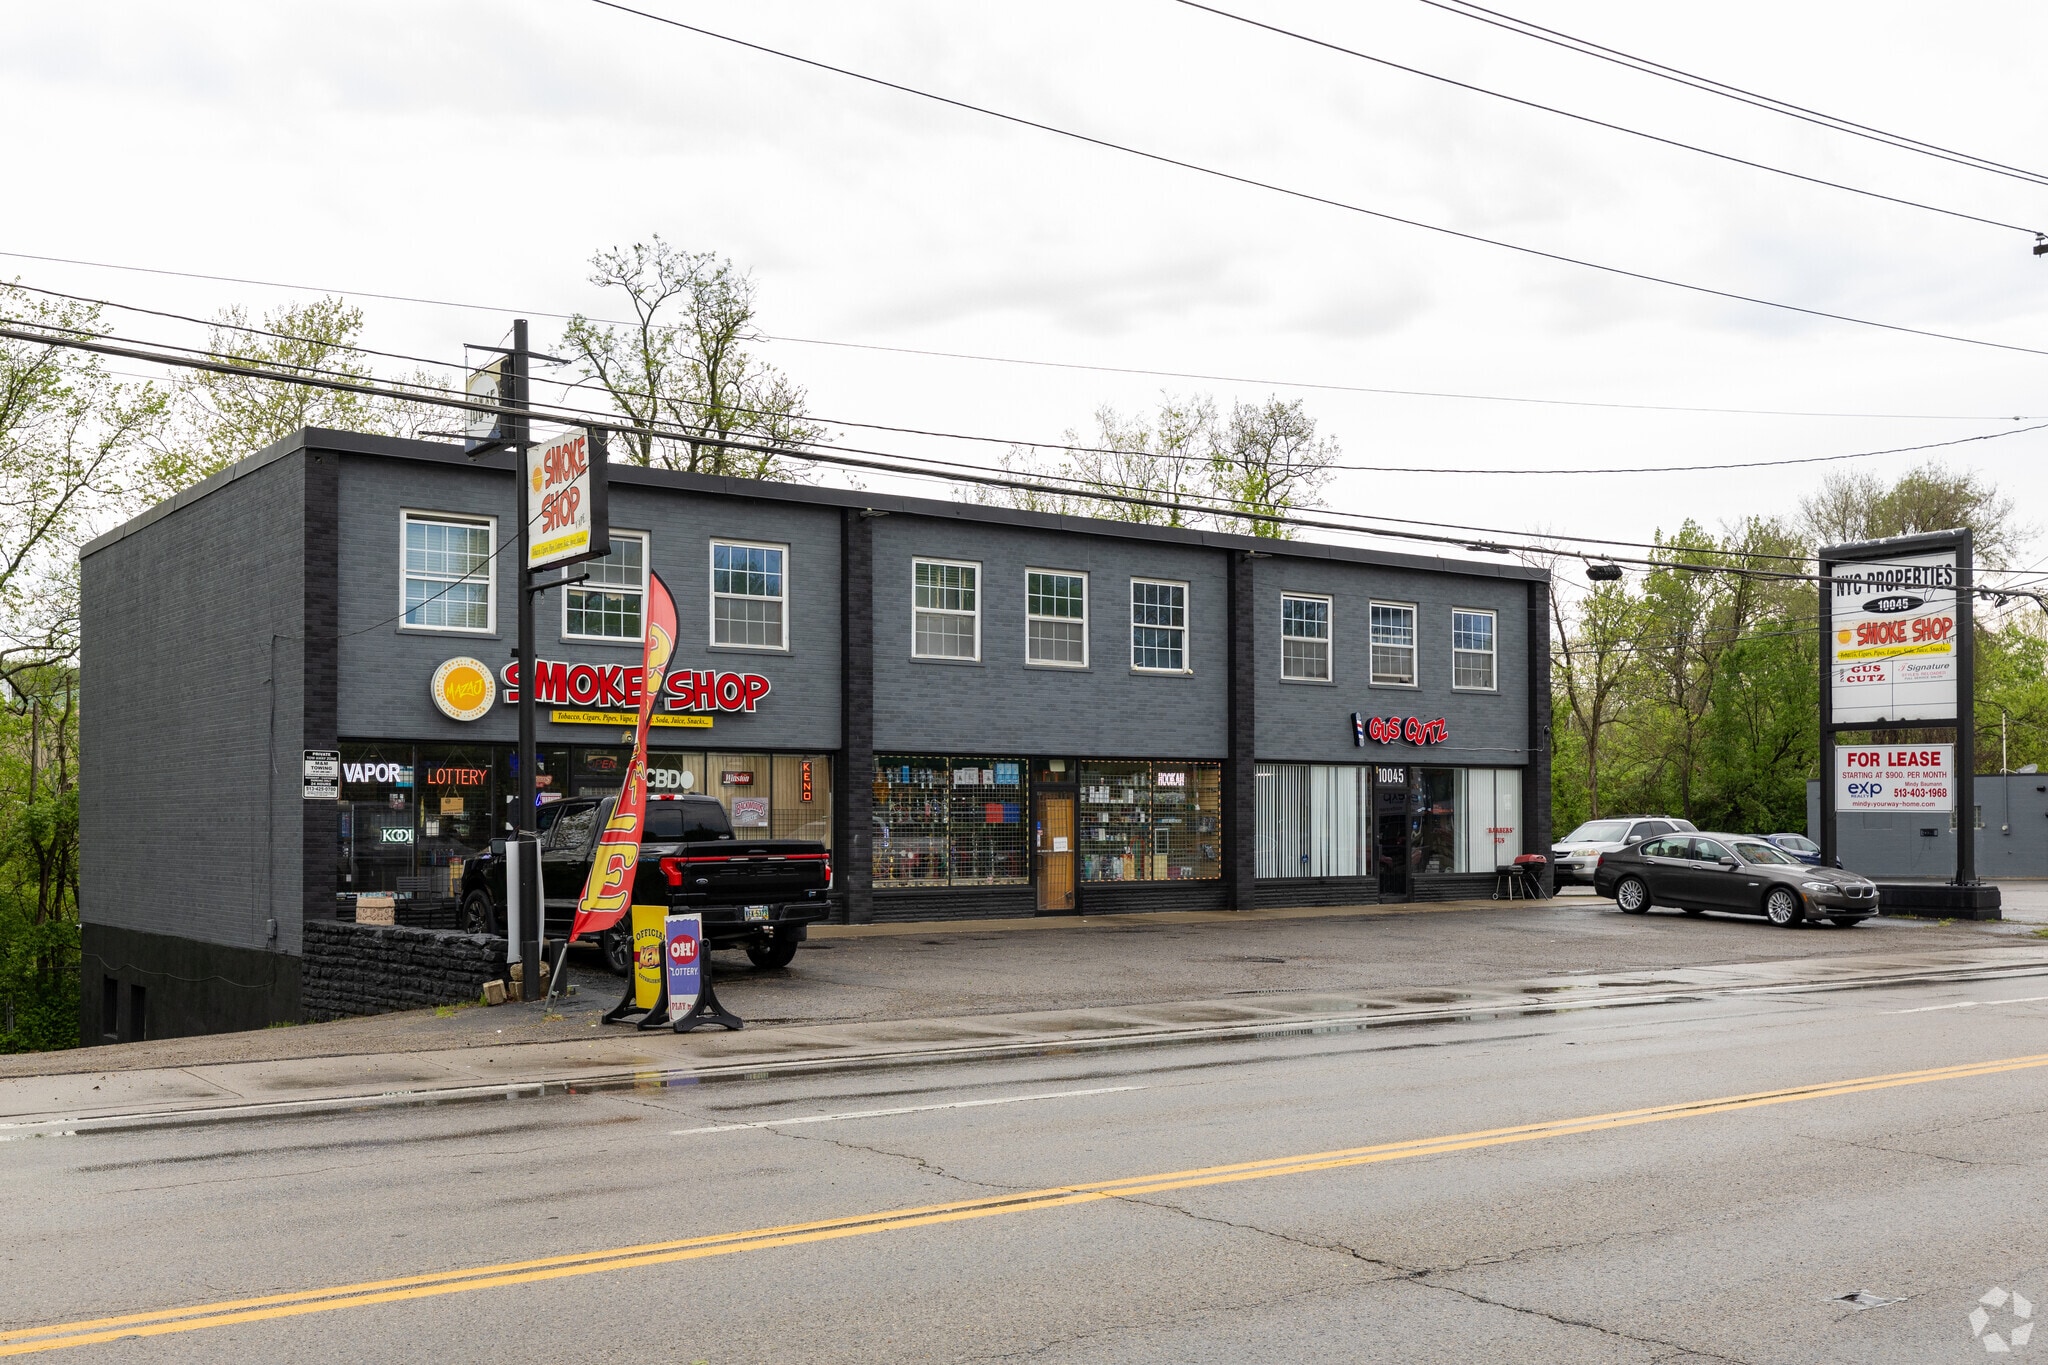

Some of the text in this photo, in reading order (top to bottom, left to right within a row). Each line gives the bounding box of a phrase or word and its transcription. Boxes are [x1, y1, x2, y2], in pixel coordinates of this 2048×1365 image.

[543, 434, 587, 490] SMOKE
[541, 486, 581, 534] SHOP
[1836, 563, 1953, 597] NYC PROPERTIES
[1878, 598, 1909, 611] 10045
[1856, 617, 1954, 646] SMOKE SHOP
[1851, 664, 1881, 673] GUS
[1906, 663, 1950, 672] Signature
[1846, 674, 1886, 683] CUTZ
[446, 678, 484, 701] MAZAJ
[664, 668, 772, 713] SHOP
[557, 712, 581, 720] Tobacco,
[582, 713, 601, 722] Cigars,
[602, 714, 618, 723] Pipes,
[620, 715, 634, 723] Vape,
[670, 717, 686, 725] Juice,
[1367, 716, 1448, 746] GUS CUTZ
[587, 759, 617, 769] OPEN
[1847, 751, 1941, 767] FOR LEASE
[342, 763, 401, 782] VAPOR
[427, 768, 487, 785] LOTTERY
[646, 768, 681, 789] CBD
[724, 773, 750, 783] Winston
[1157, 772, 1185, 786] HOOKAH
[1378, 768, 1404, 783] 10045
[1842, 771, 1873, 779] STARTING
[803, 763, 812, 800] KENO
[382, 829, 414, 842] KOOL
[670, 940, 696, 958] OH!
[639, 946, 660, 969] KEN
[672, 1002, 687, 1011] PLAY
